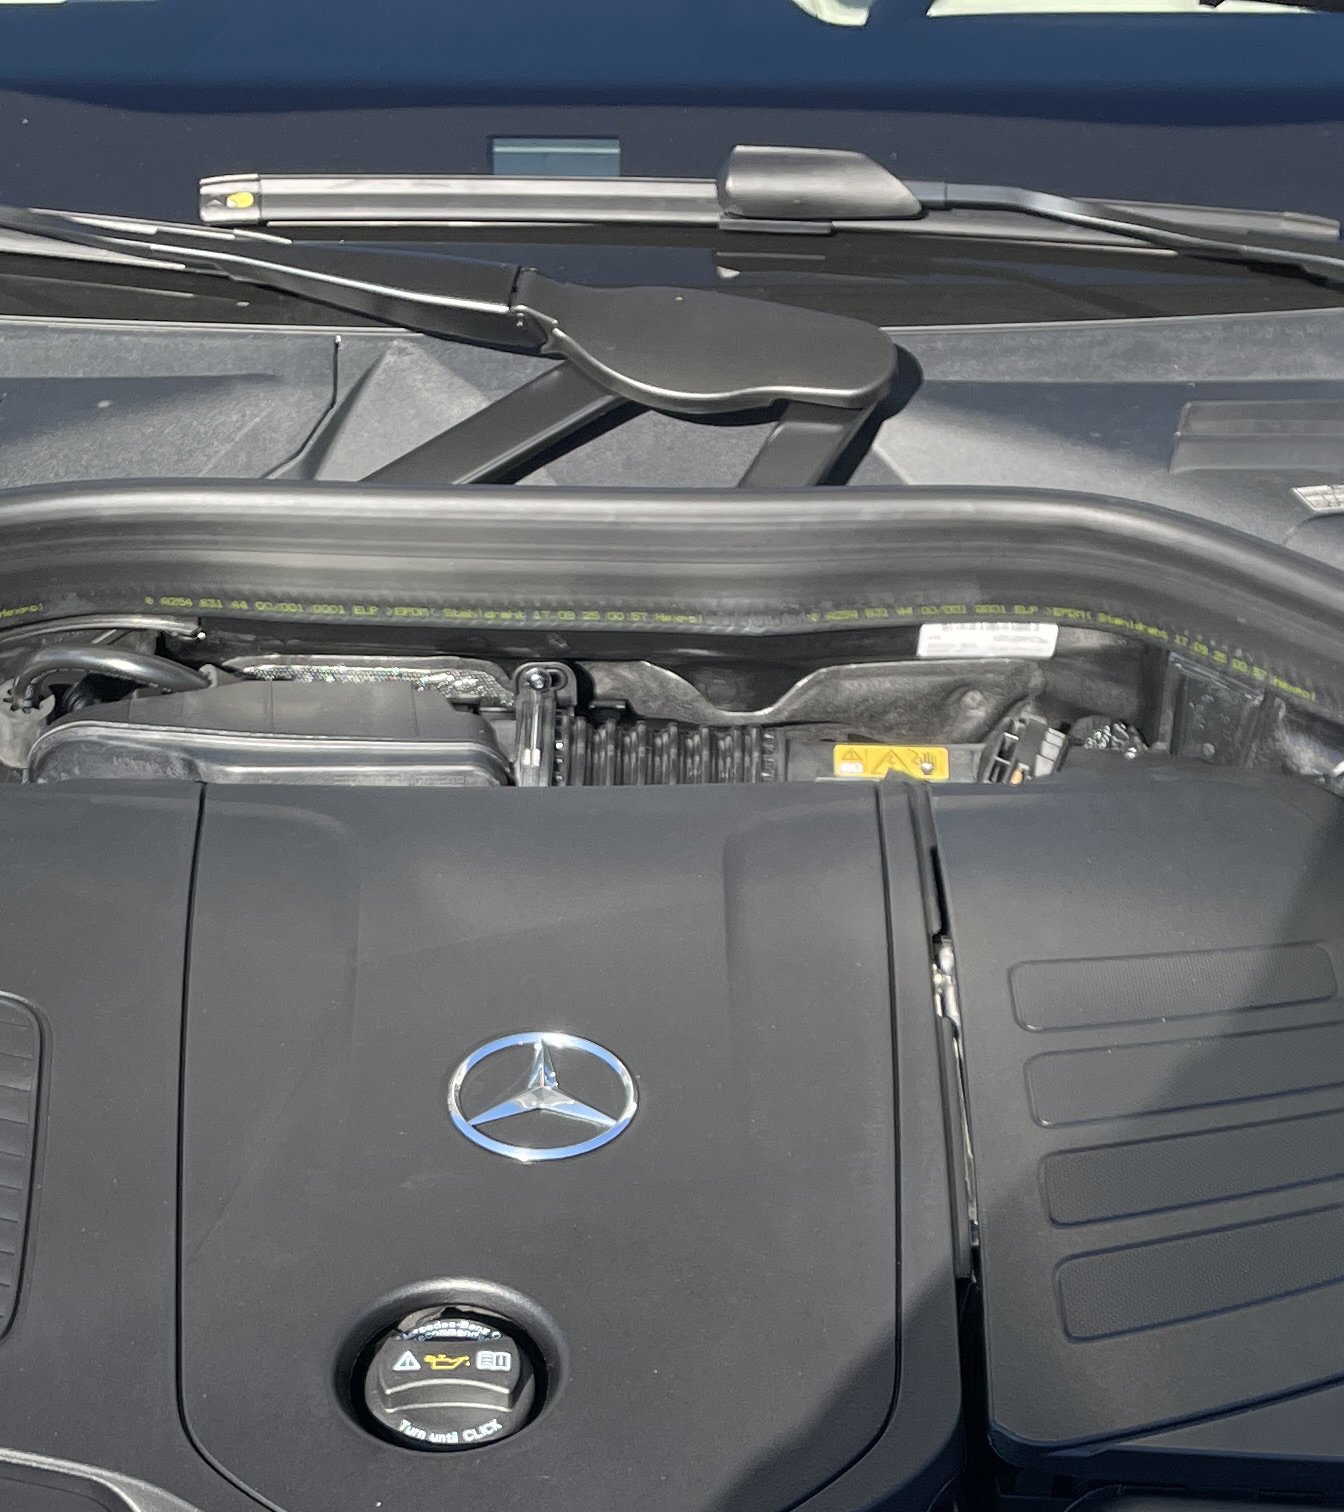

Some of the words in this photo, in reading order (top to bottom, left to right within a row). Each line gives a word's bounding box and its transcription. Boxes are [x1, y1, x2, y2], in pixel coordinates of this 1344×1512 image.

[399, 1419, 427, 1440] Turn
[429, 1431, 459, 1443] until
[462, 1418, 503, 1442] CLICK
